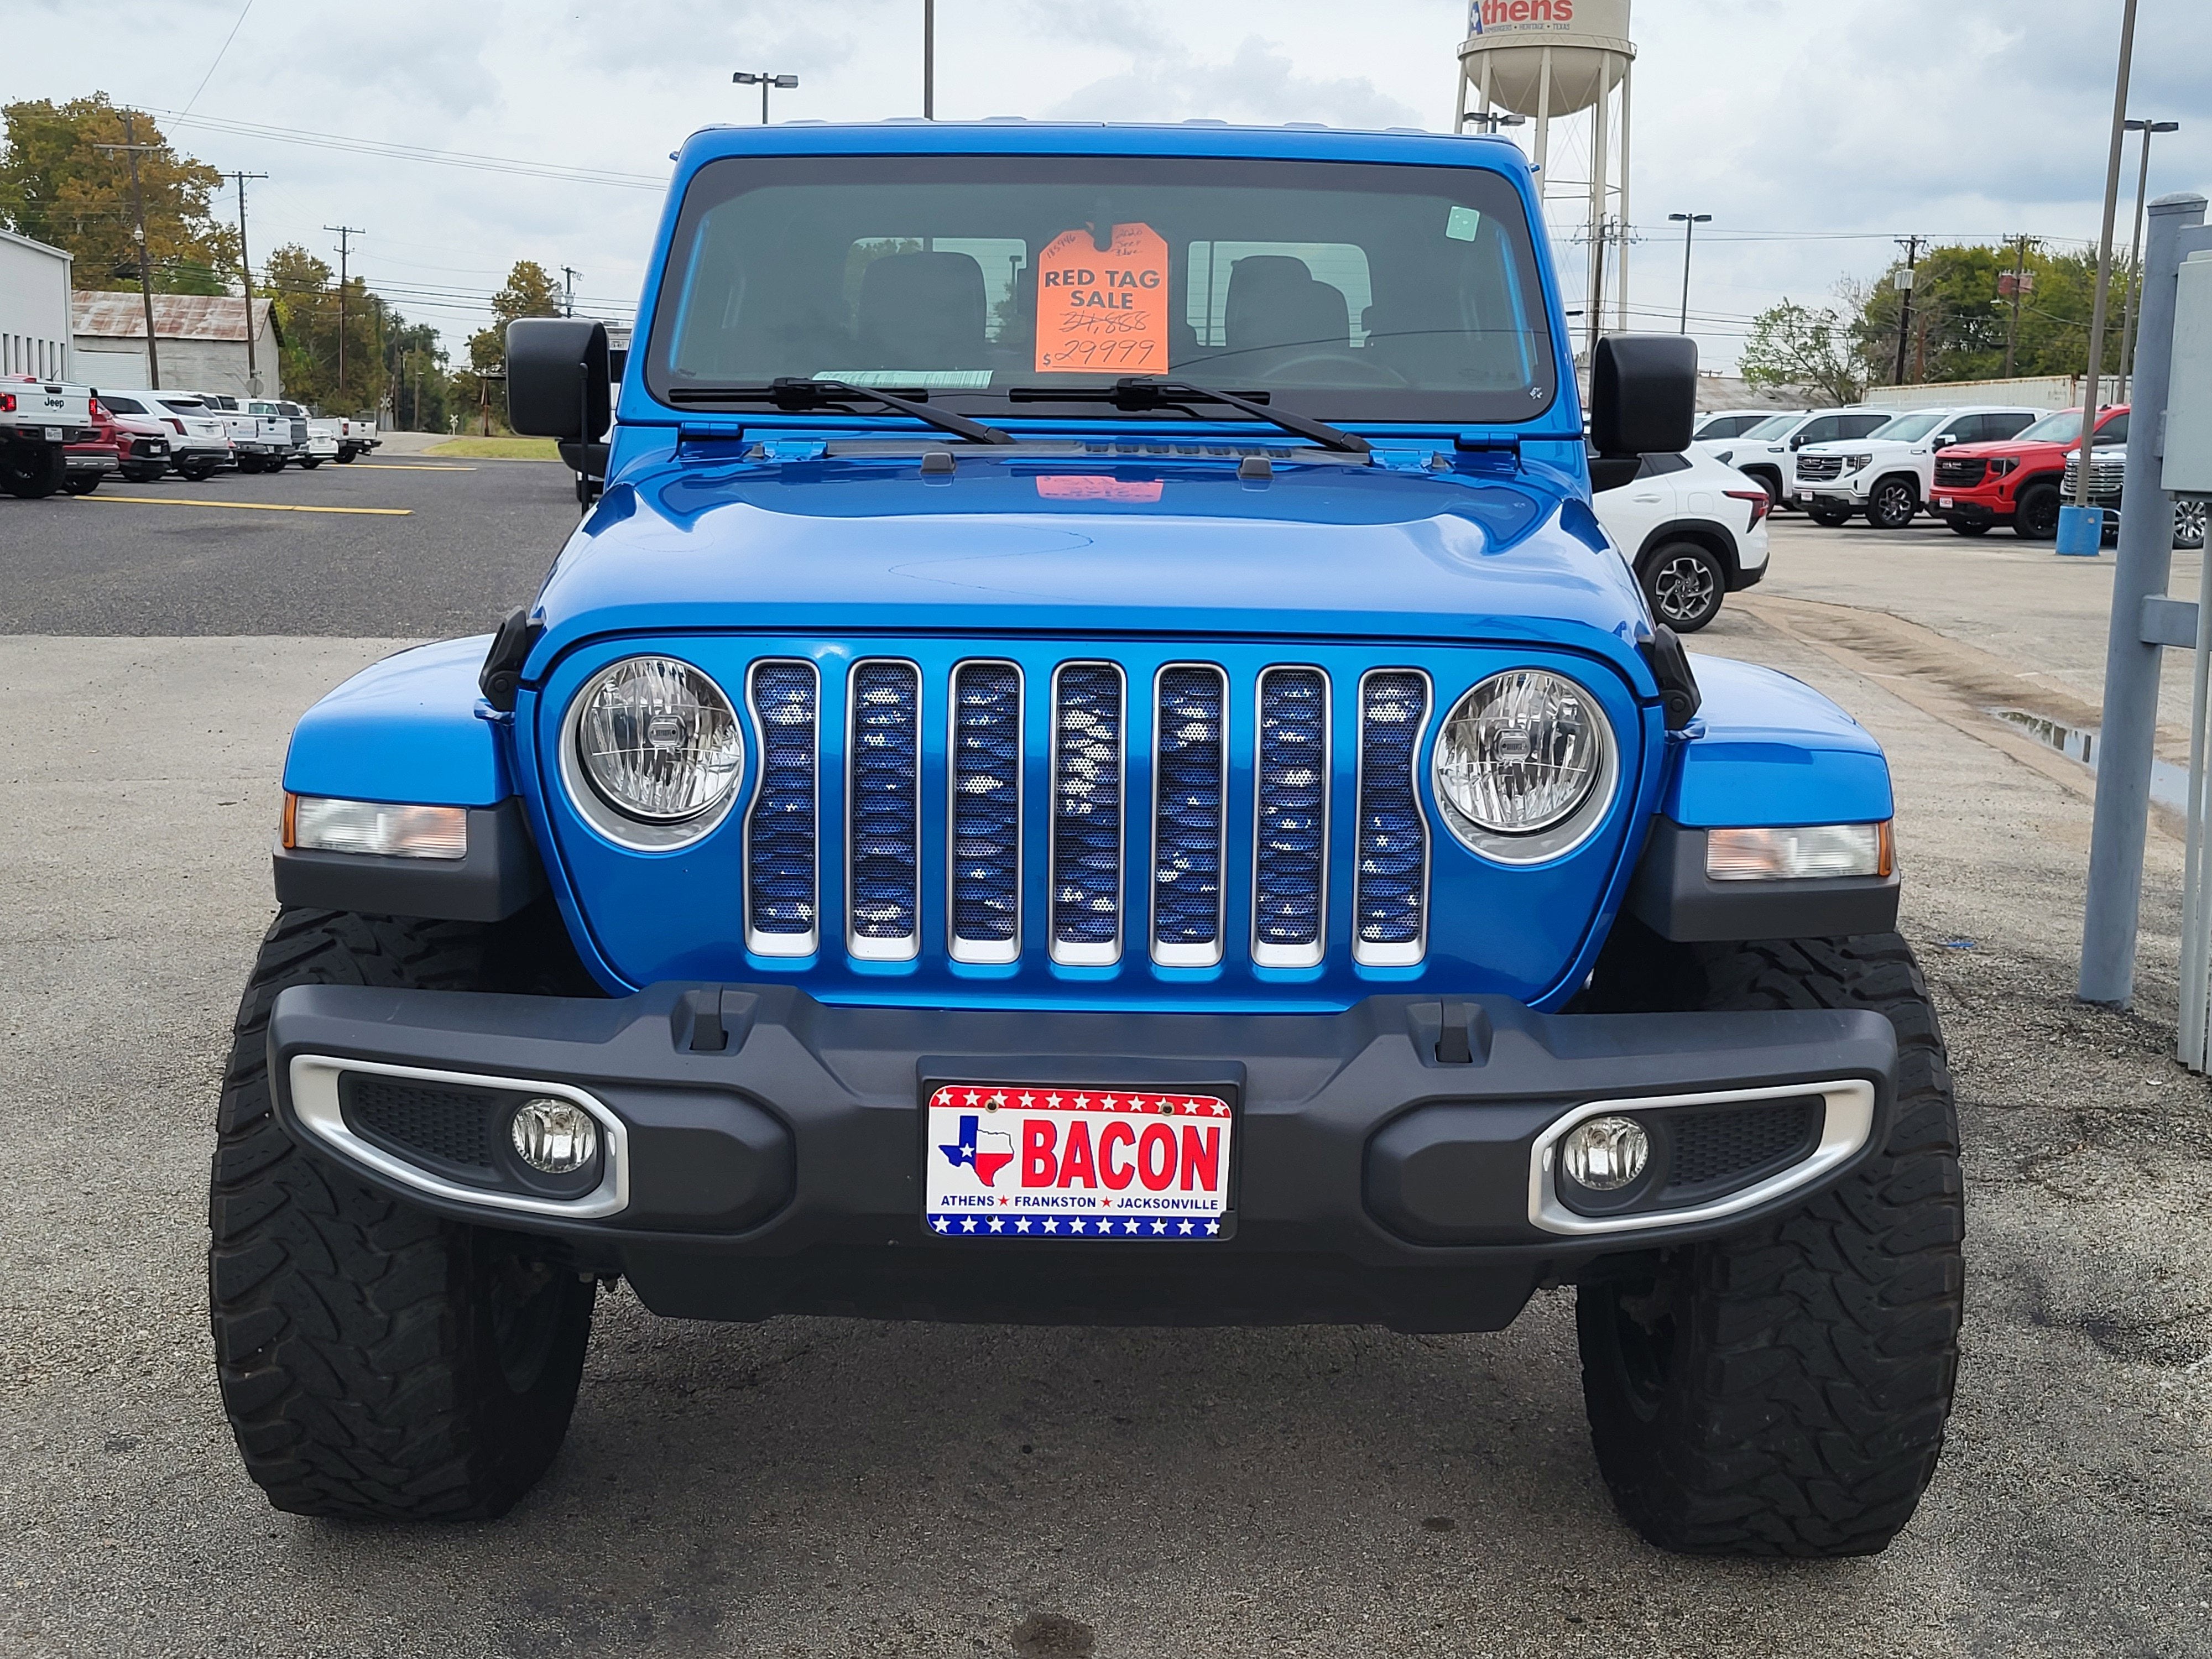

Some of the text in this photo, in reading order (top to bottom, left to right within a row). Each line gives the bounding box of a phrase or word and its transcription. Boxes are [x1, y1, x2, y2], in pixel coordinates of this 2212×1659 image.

[1467, 0, 1573, 38] Athens
[1045, 269, 1160, 289] RED TAG
[1071, 290, 1134, 310] SALE
[44, 397, 65, 409] Jeep
[1021, 1119, 1220, 1192] BACON
[941, 1196, 1219, 1211] ATHENS FRANKSTON JACKSONVILLE
